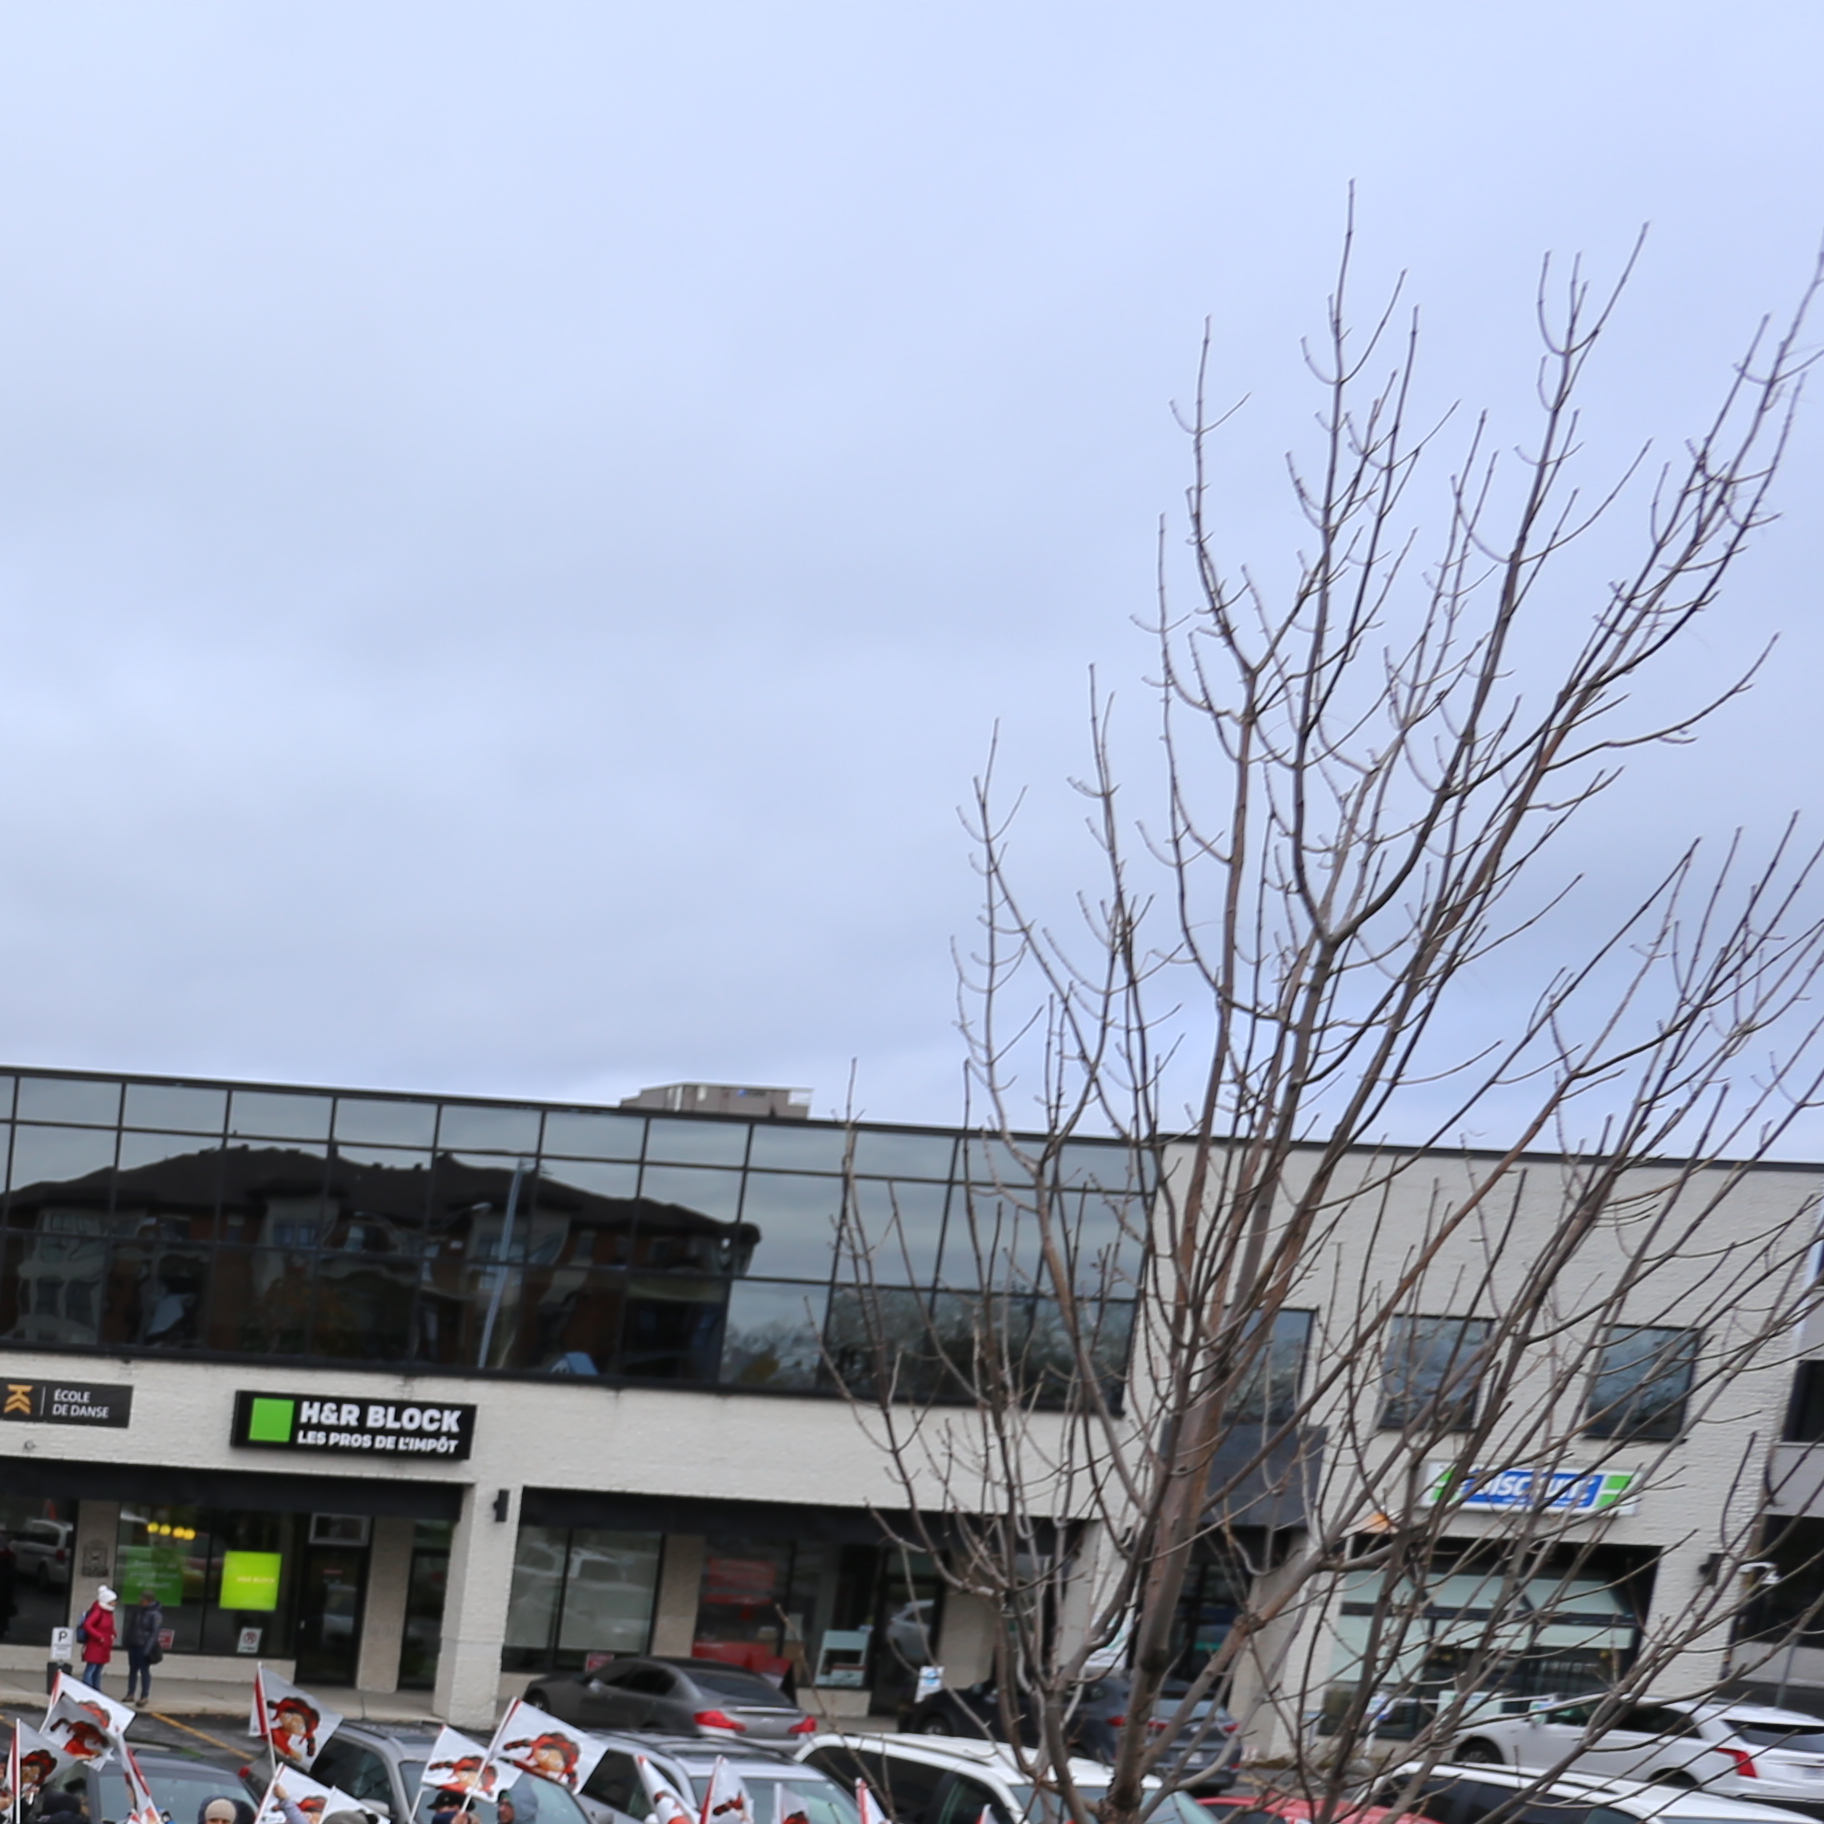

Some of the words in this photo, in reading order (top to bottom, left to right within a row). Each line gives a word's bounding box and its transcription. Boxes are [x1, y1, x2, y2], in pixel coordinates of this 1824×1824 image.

[54, 1388, 91, 1404] ÉCOLE
[53, 1404, 69, 1416] DE
[70, 1405, 109, 1419] DANSE
[300, 1401, 361, 1427] H&R
[366, 1405, 462, 1432] BLOCK
[297, 1430, 327, 1445] LES
[328, 1431, 373, 1448] PROS
[374, 1434, 396, 1449] DE
